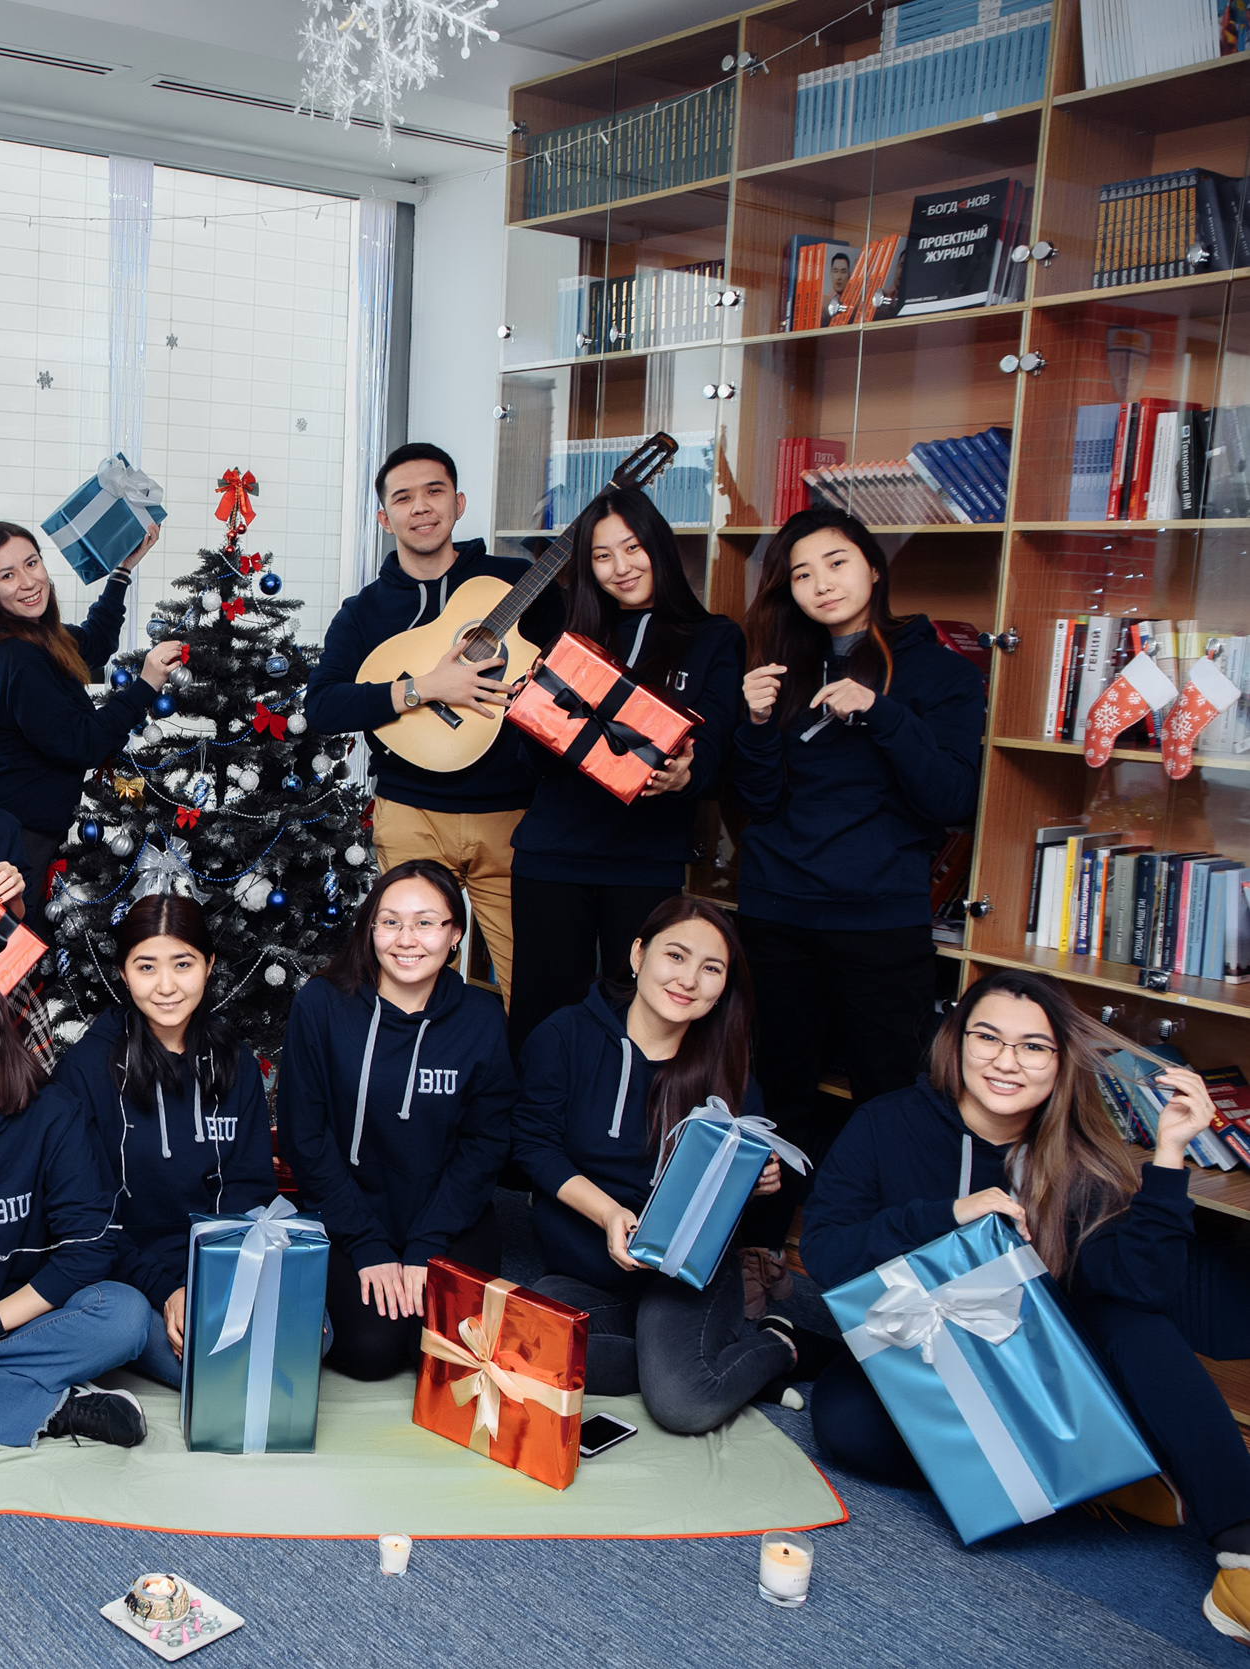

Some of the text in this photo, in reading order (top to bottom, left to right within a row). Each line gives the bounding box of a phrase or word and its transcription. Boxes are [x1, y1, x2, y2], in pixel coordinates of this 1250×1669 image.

[918, 224, 989, 250] ПРОЕКТНЫЙ
[923, 243, 975, 264] ЖУРНАЛ
[814, 451, 836, 464] ПЯТЬ
[1182, 439, 1192, 509] Технология BIM
[1088, 630, 1101, 672] ГЕНИЙ
[1136, 898, 1147, 928] НИЩЕТА!
[1133, 929, 1145, 960] ПРОЩАЙ,
[418, 1068, 459, 1094] BIU
[206, 1116, 238, 1141] BIU
